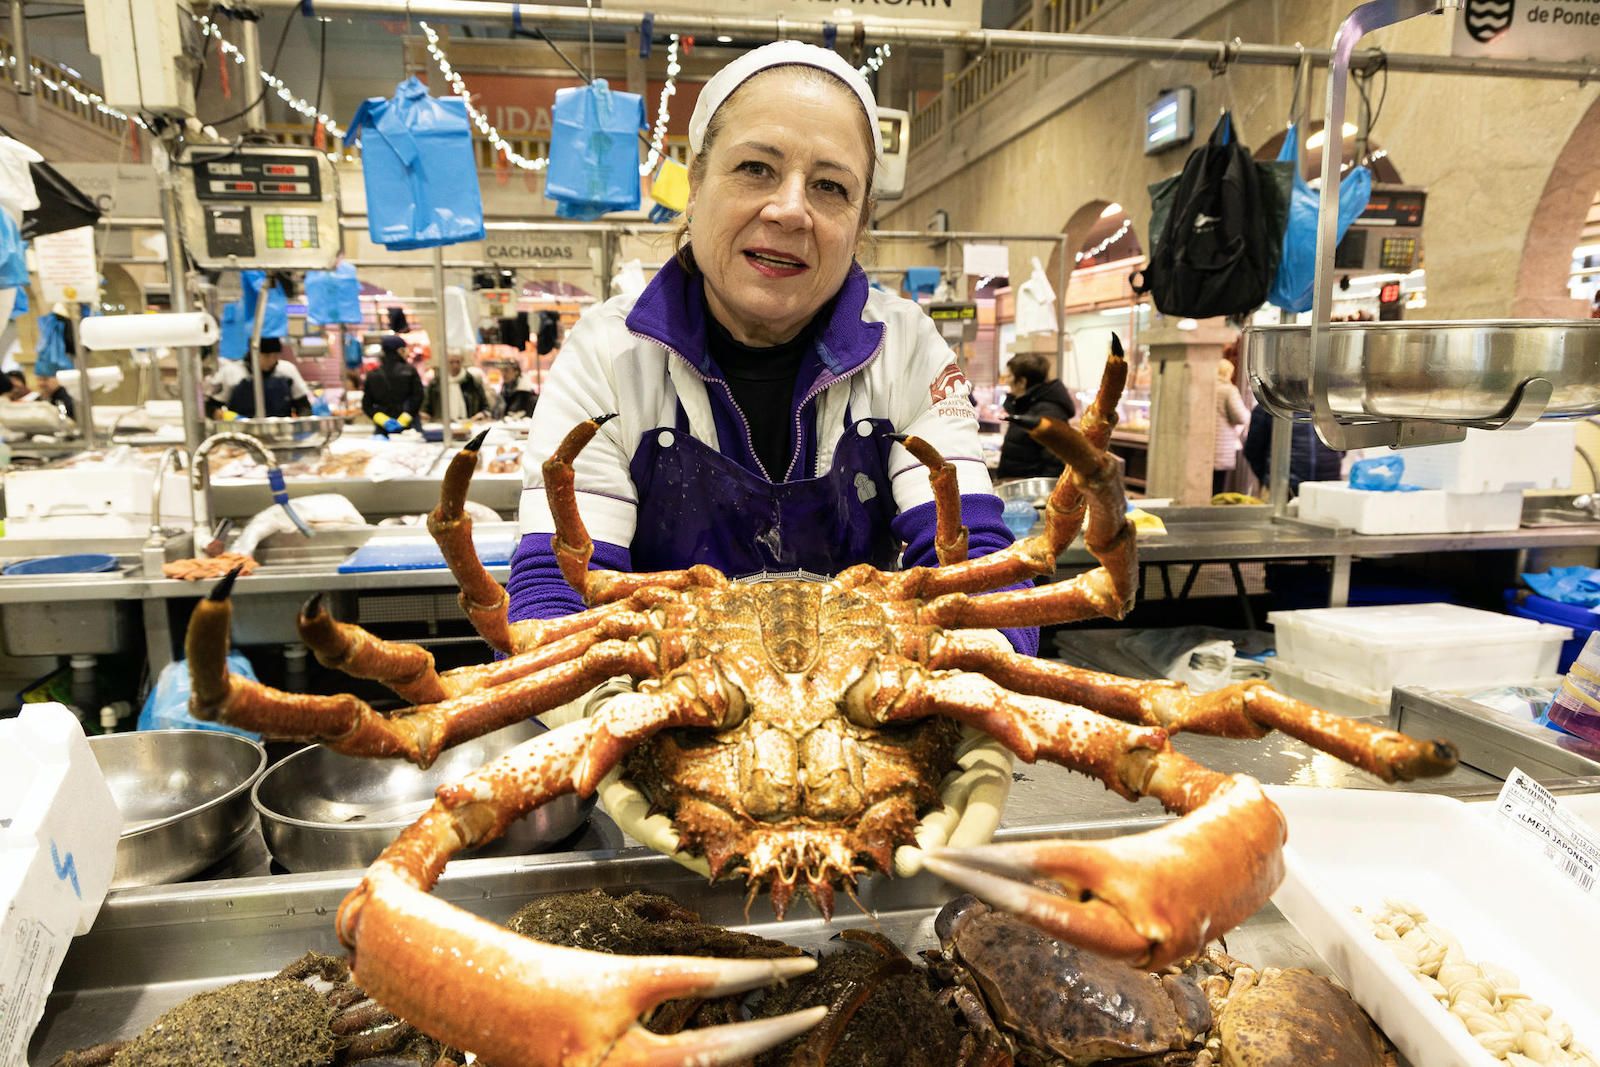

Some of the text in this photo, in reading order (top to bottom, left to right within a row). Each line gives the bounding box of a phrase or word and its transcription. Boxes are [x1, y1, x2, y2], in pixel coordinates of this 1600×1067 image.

[1527, 6, 1549, 23] de
[486, 245, 573, 258] CACHADAS
[1552, 835, 1594, 872] JAPONESA
